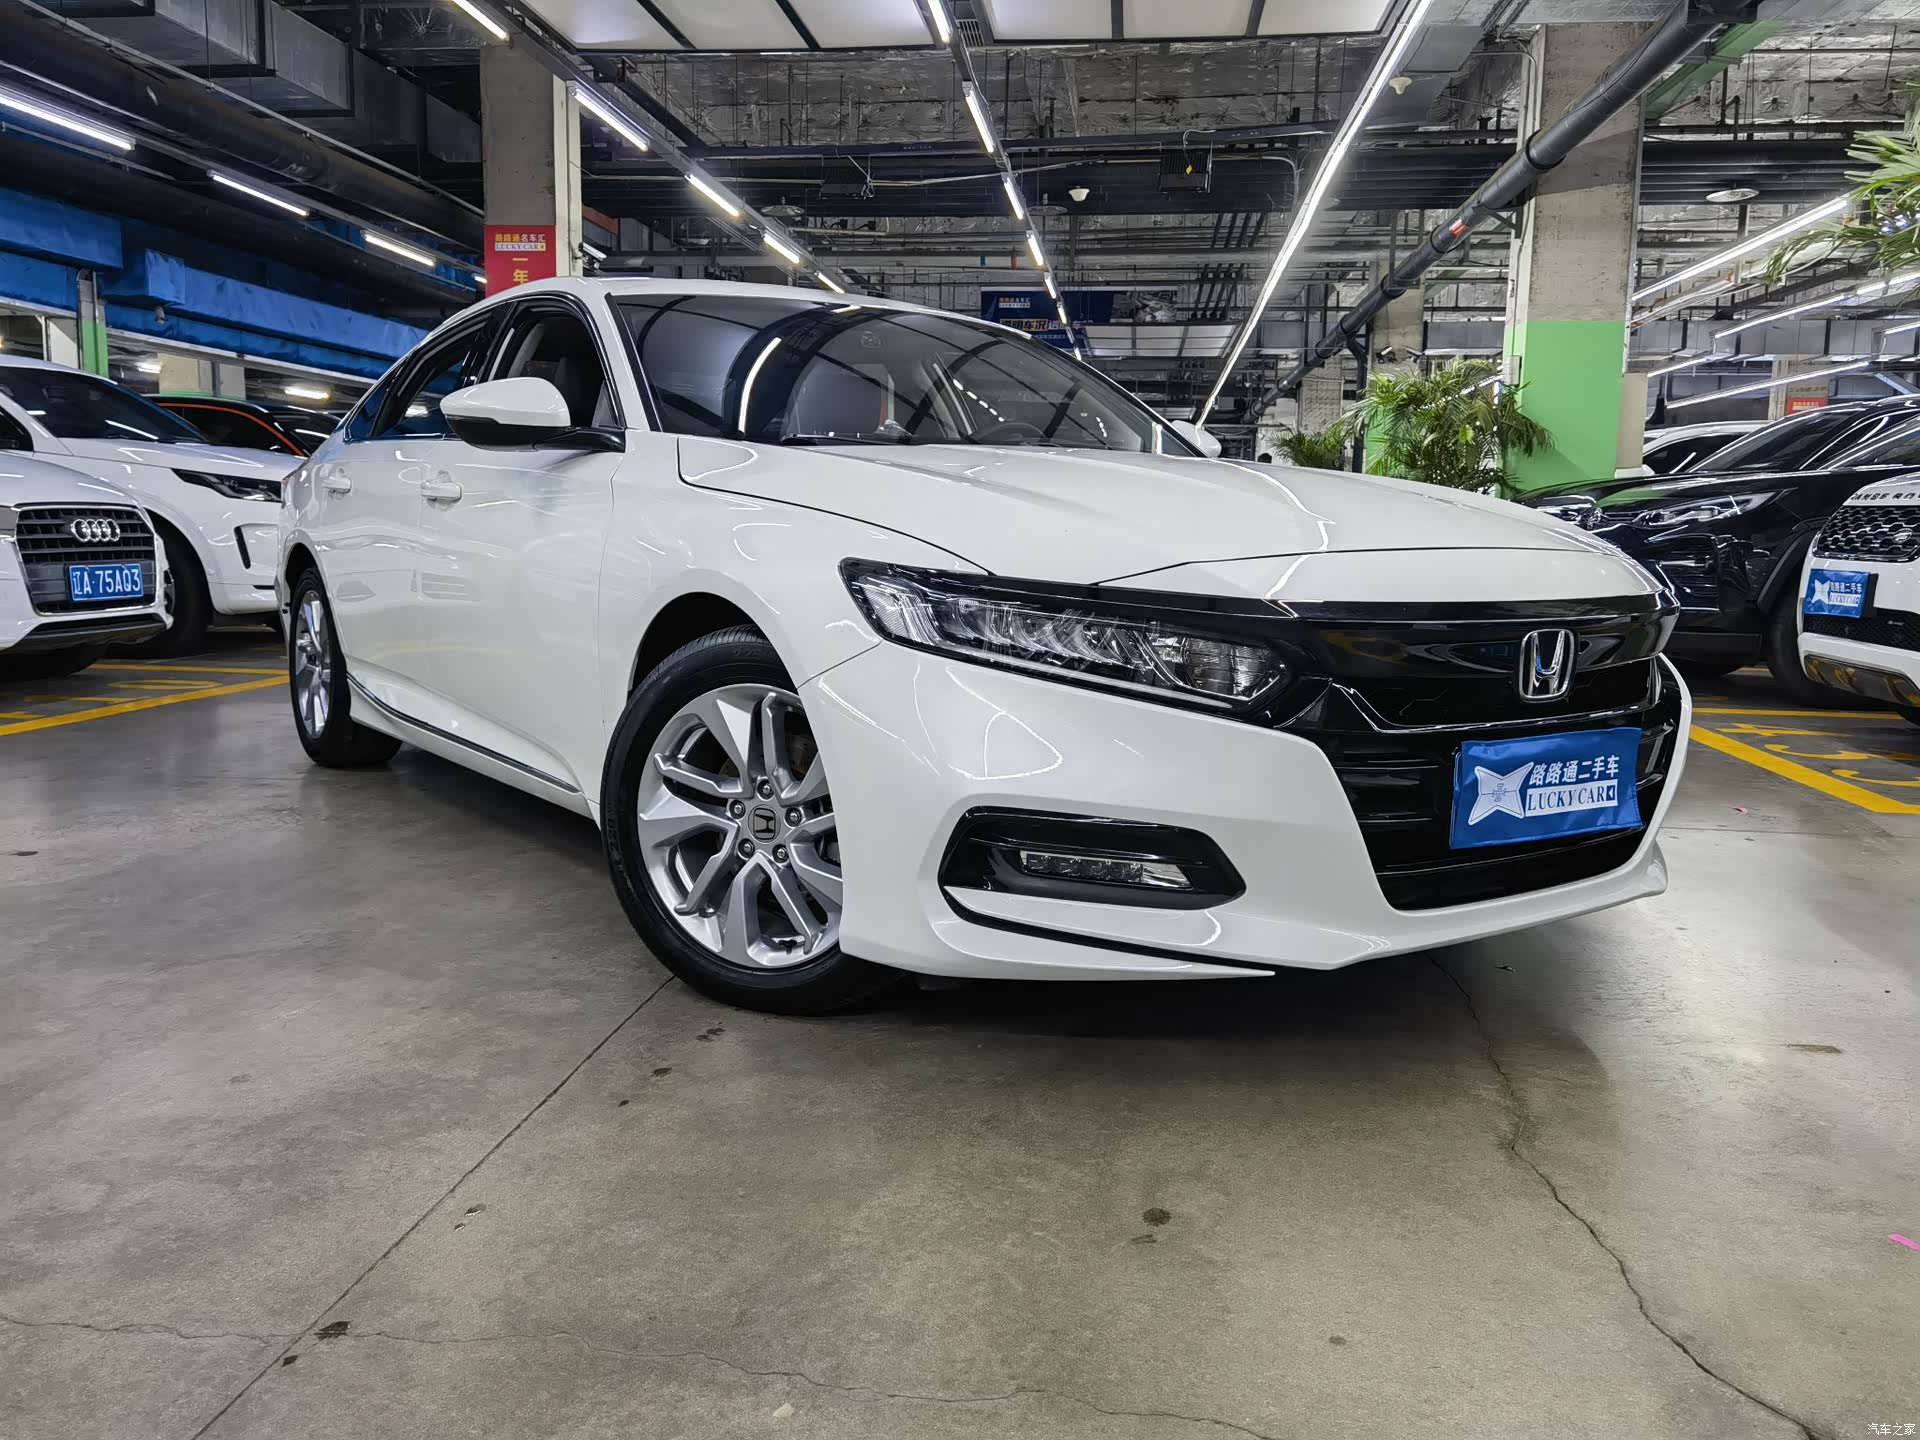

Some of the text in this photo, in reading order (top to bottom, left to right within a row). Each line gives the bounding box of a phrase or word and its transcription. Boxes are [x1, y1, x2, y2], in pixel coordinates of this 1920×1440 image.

[1892, 492, 1920, 500] RO
[1528, 754, 1621, 786] 路路通二手车
[1527, 787, 1605, 812] LUCKY CAR
